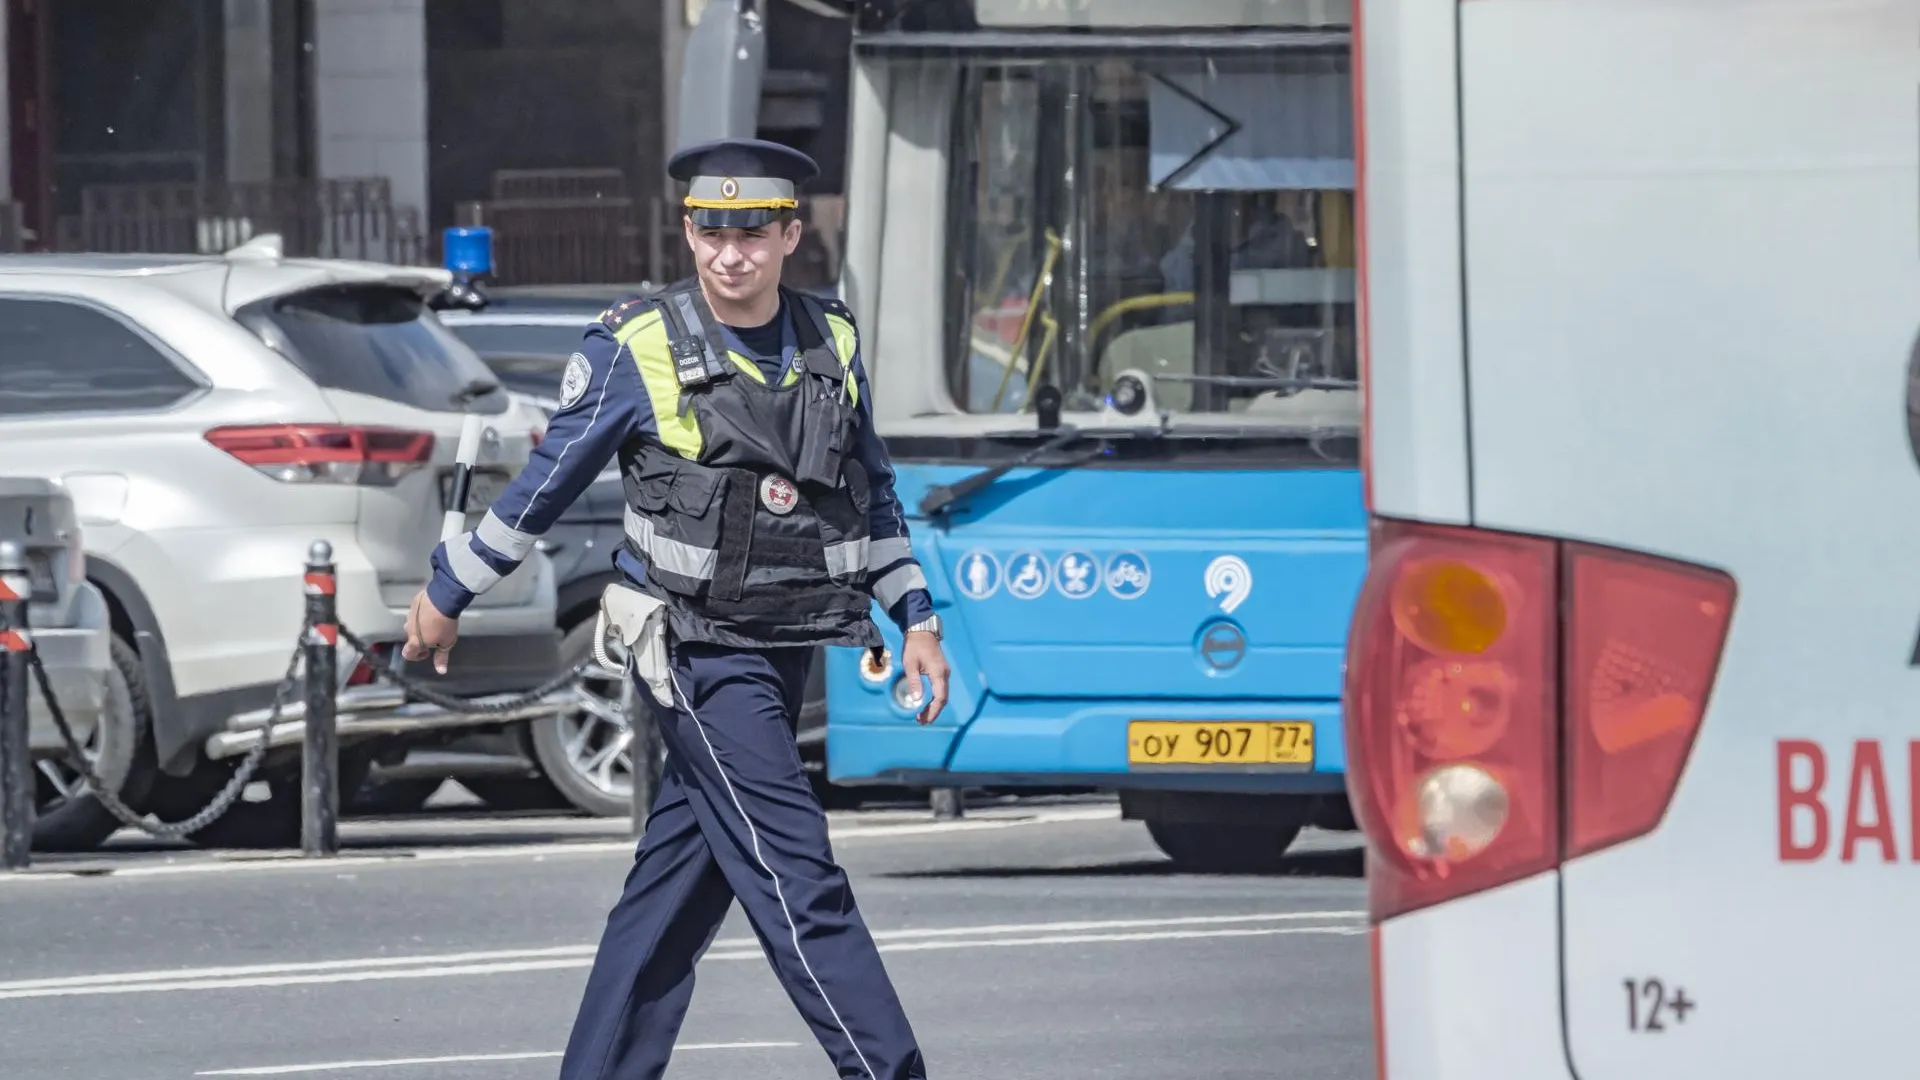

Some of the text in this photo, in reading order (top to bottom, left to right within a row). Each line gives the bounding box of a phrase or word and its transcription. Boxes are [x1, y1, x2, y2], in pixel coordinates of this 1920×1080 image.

[1195, 727, 1252, 758] 907
[1272, 726, 1301, 748] 77
[1622, 977, 1697, 1033] 12+
